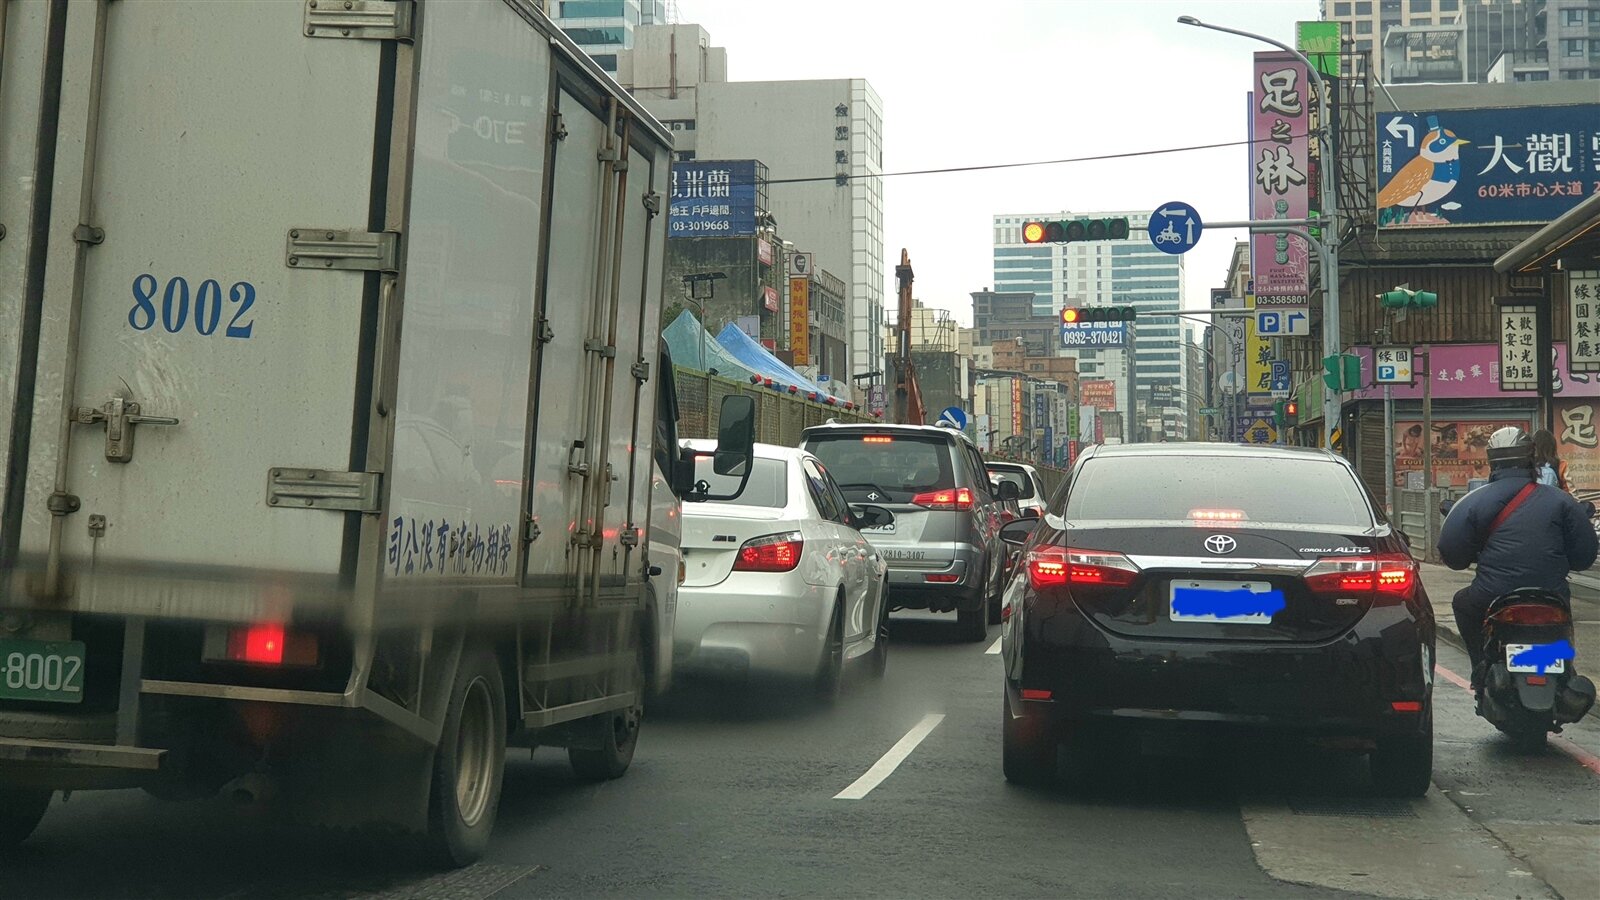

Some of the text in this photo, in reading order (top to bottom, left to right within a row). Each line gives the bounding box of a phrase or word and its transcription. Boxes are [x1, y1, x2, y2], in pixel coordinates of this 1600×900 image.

[1256, 67, 1307, 196] 足之林
[1476, 132, 1574, 176] 大觀
[1477, 180, 1583, 198] 60米市心大道
[672, 220, 730, 231] 03-3019668
[128, 272, 257, 339] 8002
[1256, 295, 1307, 305] 03-3585801
[1574, 283, 1593, 358] 緣圓餐廳
[1063, 330, 1123, 345] 0932-370421
[1378, 350, 1408, 363] 緣圓
[1504, 317, 1519, 379] 大宴小酌
[1519, 316, 1534, 379] 歡迎光臨
[1560, 404, 1600, 449] 足
